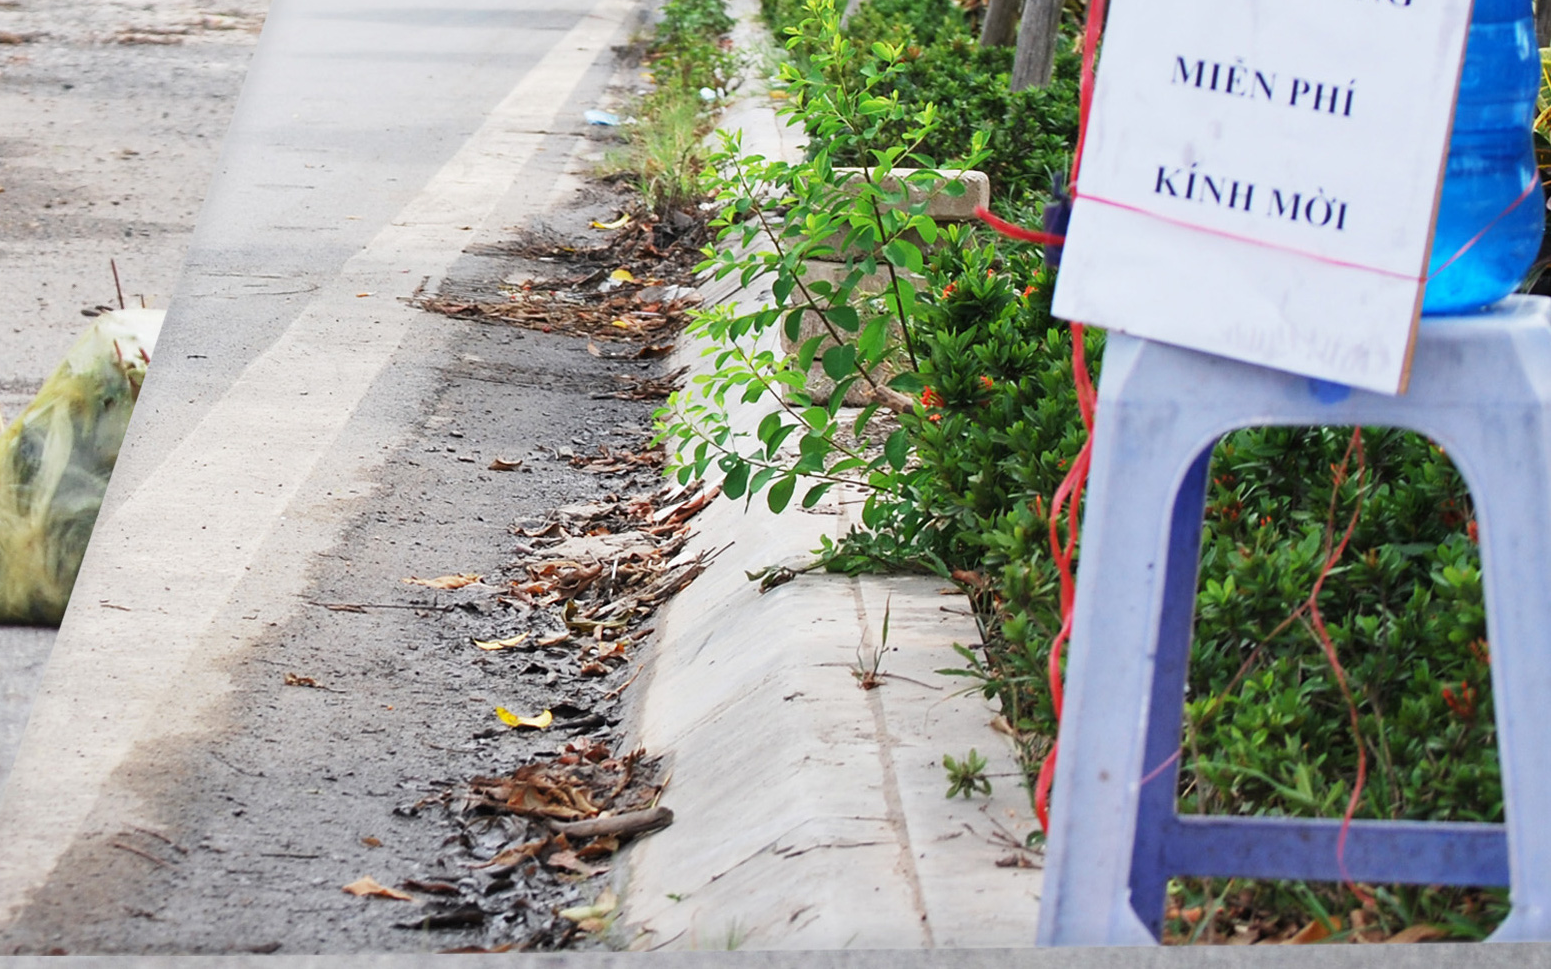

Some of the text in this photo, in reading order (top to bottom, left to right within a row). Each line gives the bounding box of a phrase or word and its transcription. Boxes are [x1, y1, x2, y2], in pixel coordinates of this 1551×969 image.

[1288, 77, 1357, 118] PHÍ
[1153, 161, 1349, 232] KÍNH MỜI
